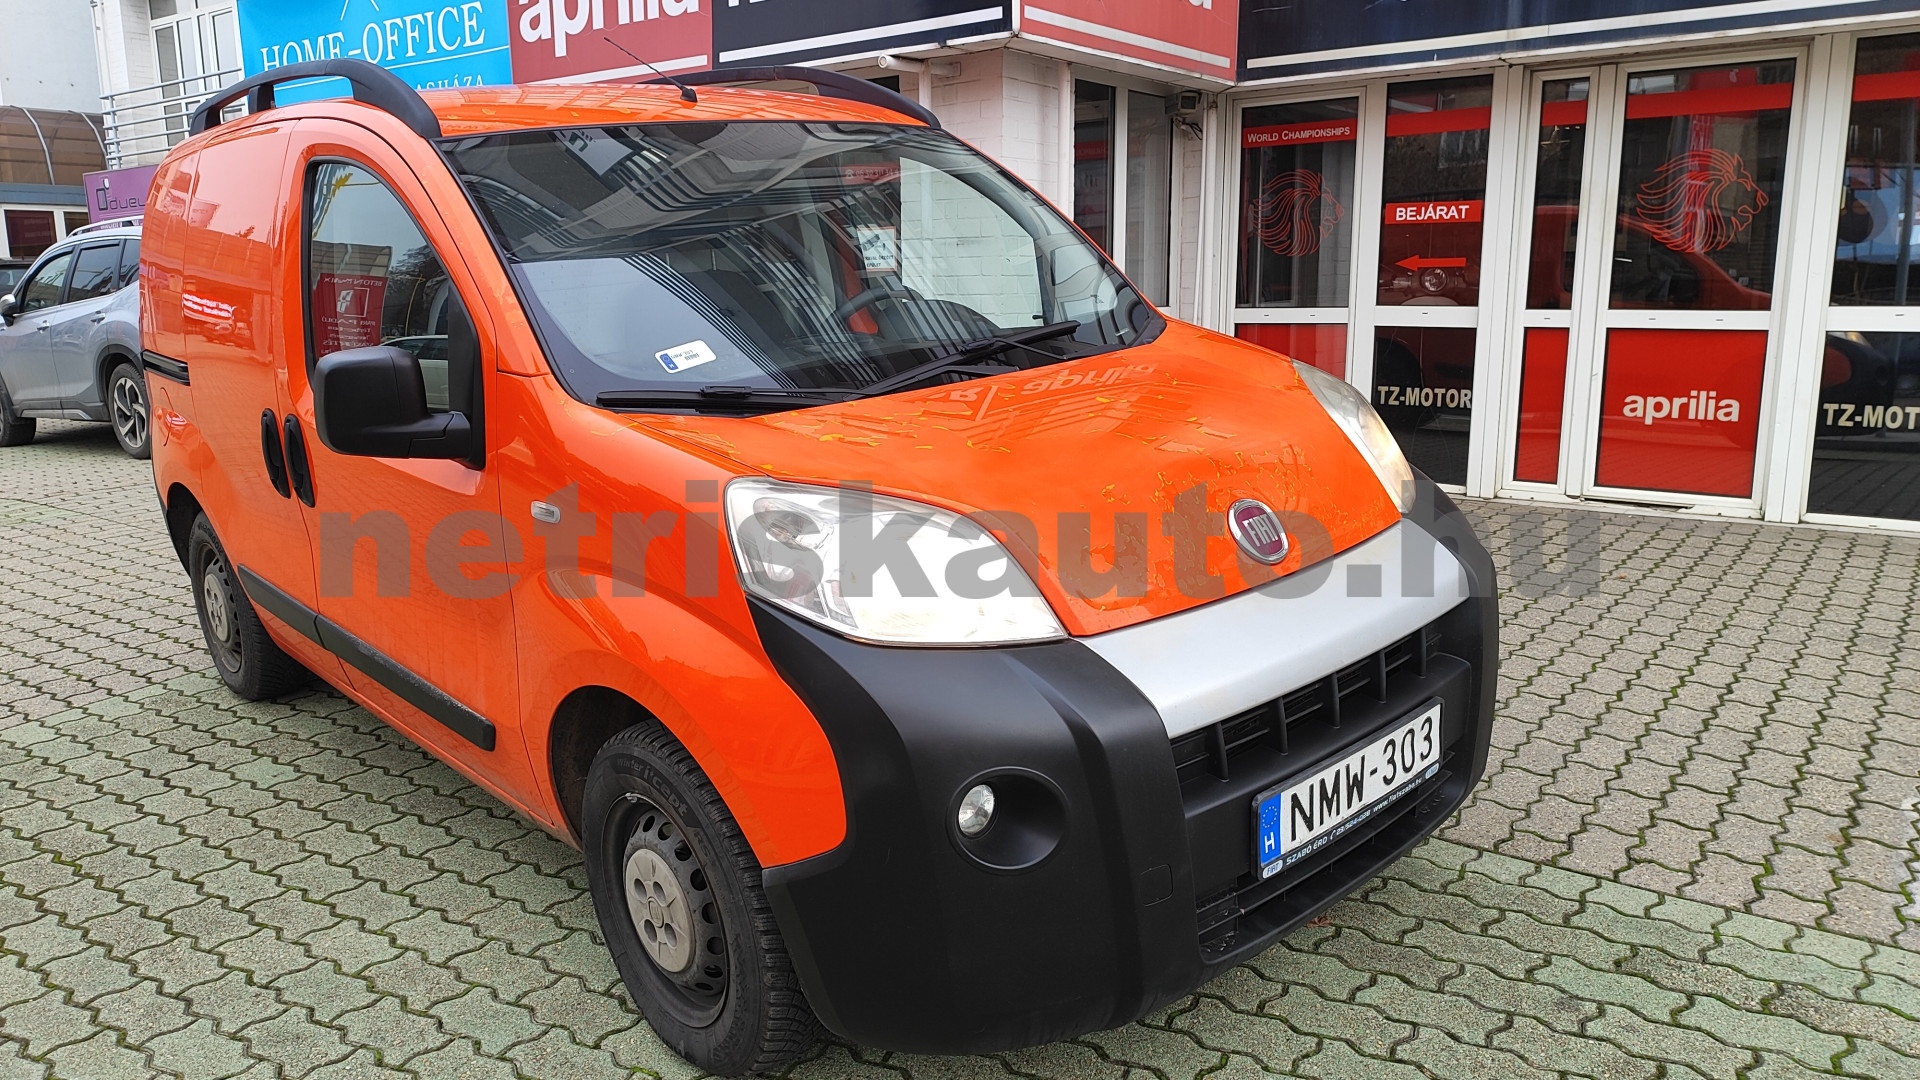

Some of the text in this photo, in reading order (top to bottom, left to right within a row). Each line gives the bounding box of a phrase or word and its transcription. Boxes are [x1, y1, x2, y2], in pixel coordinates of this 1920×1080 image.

[260, 1, 486, 71] HOME-OFFICE
[1395, 203, 1470, 221] BEJÁRAT
[1377, 385, 1472, 409] TZ-MOTOR
[1622, 390, 1740, 425] aprilia
[1823, 403, 1920, 430] TZ-MOT
[1242, 513, 1279, 547] FIAT
[1290, 715, 1433, 842] NMW-303
[1263, 832, 1276, 854] H
[1286, 844, 1312, 866] SZABÓ
[1313, 835, 1328, 850] ÉRD
